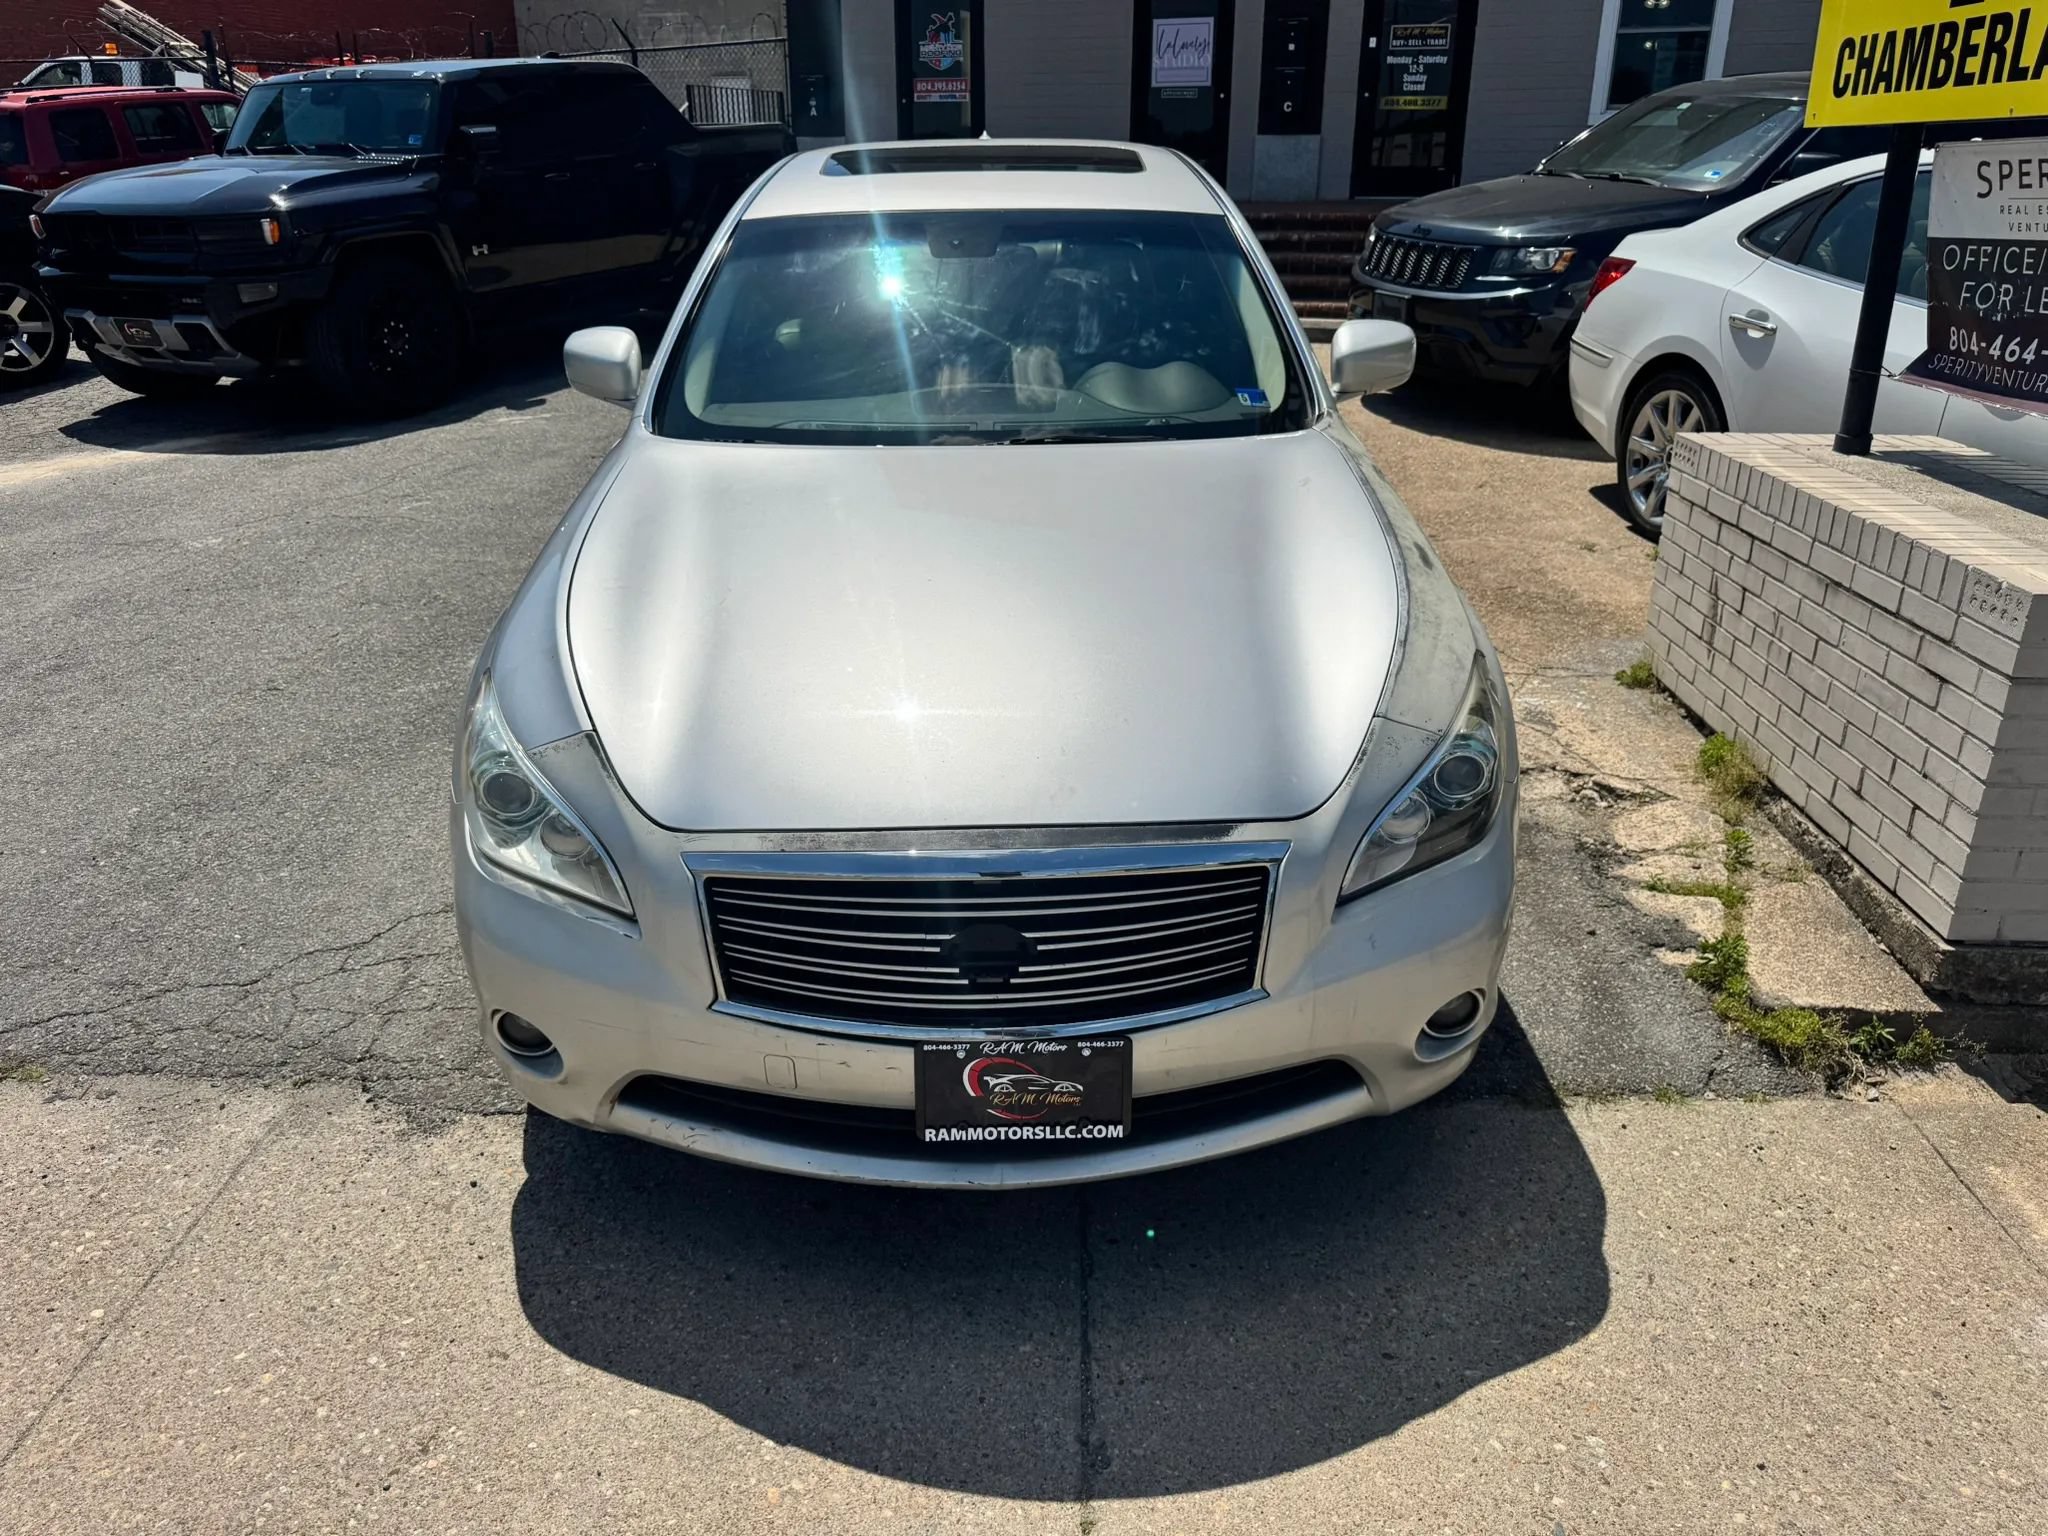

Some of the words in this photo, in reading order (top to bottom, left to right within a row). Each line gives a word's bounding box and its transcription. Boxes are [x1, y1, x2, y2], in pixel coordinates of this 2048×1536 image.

[1427, 38, 1447, 46] TRADE
[1387, 56, 1412, 64] Monday
[1418, 55, 1448, 64] Saturday
[1409, 64, 1424, 73] 12-5
[1403, 74, 1427, 82] Sunday
[1403, 83, 1425, 91] Closed
[811, 106, 818, 116] A
[1283, 101, 1292, 112] C
[1976, 158, 2048, 199] SPER
[2000, 204, 2028, 215] REAL
[2008, 222, 2048, 233] VENTU
[1943, 244, 2048, 275] OFFICE/
[1959, 281, 2013, 311] FOR
[2024, 285, 2048, 314] LE
[1949, 325, 2048, 365] 804-464-
[1928, 353, 2048, 394] SPERITYVENTUR
[1028, 1041, 1068, 1053] Motors
[1039, 1093, 1081, 1105] Motors
[924, 1124, 1124, 1142] RAMMOTORSLLC.COM
